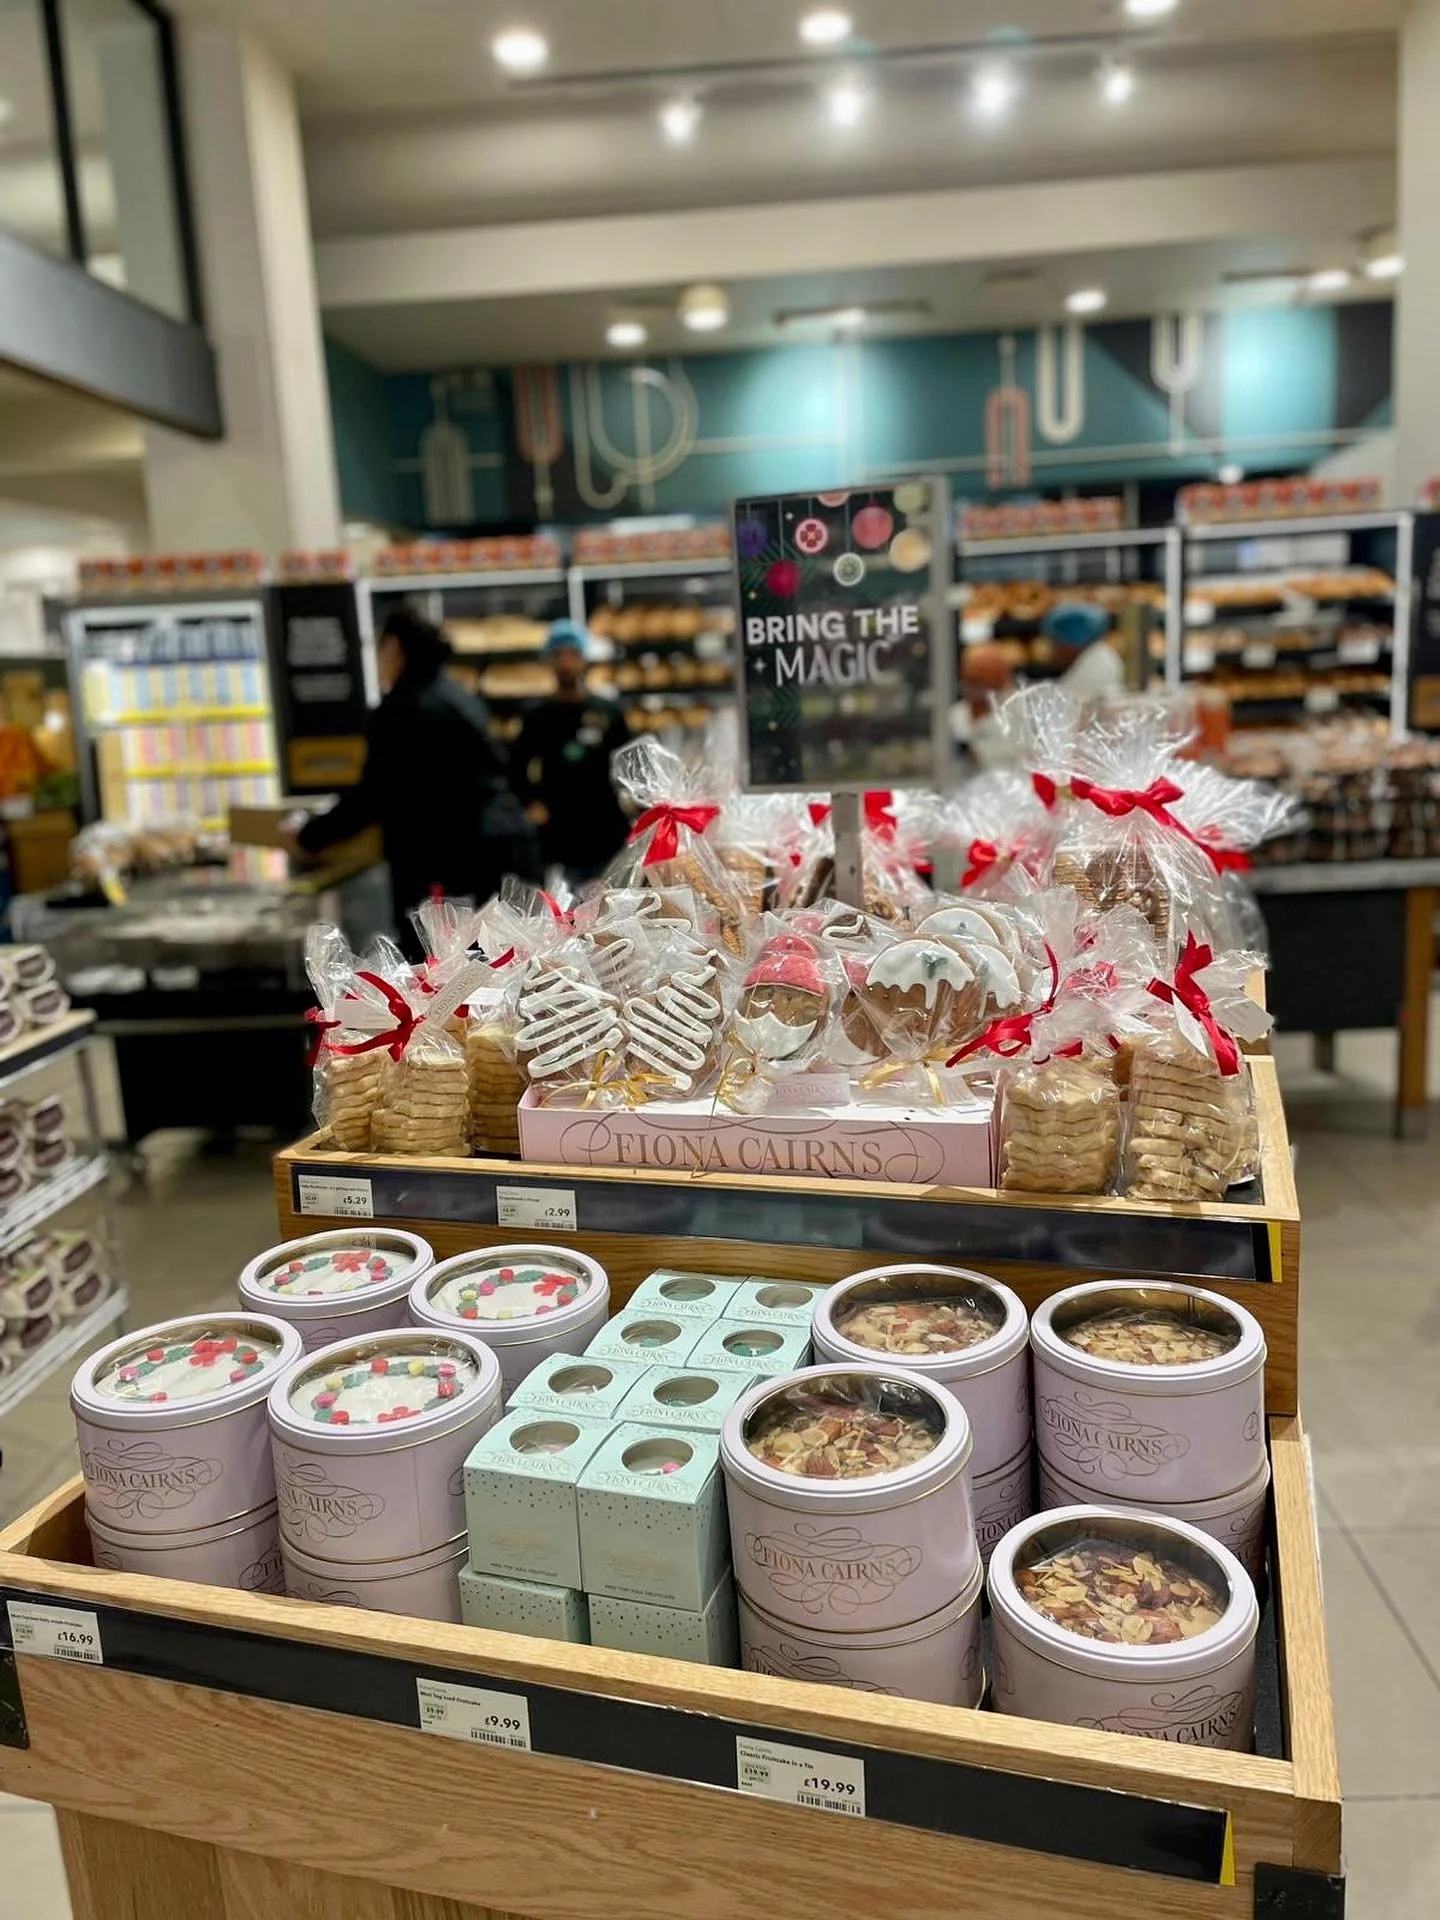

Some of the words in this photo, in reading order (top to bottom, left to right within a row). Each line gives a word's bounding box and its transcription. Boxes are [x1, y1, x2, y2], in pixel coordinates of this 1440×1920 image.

[746, 611, 847, 645] BRING
[853, 606, 919, 637] THE
[775, 639, 892, 687] MAGIC
[613, 1132, 730, 1169] FIONA
[737, 1135, 885, 1174] CAIRNS
[545, 1208, 570, 1217] £2.99
[1050, 1414, 1092, 1445] FIONA
[1094, 1431, 1162, 1454] CAIRNS
[130, 1468, 196, 1488] CAIRNS
[299, 1493, 356, 1515] CAIRNS
[762, 1546, 815, 1578] FIONA
[821, 1558, 896, 1580] CAIRNS
[58, 1631, 93, 1645] £16.99
[485, 1715, 521, 1730] £9.99
[1176, 1708, 1237, 1743] CAIRNS
[804, 1777, 855, 1795] £19.99
